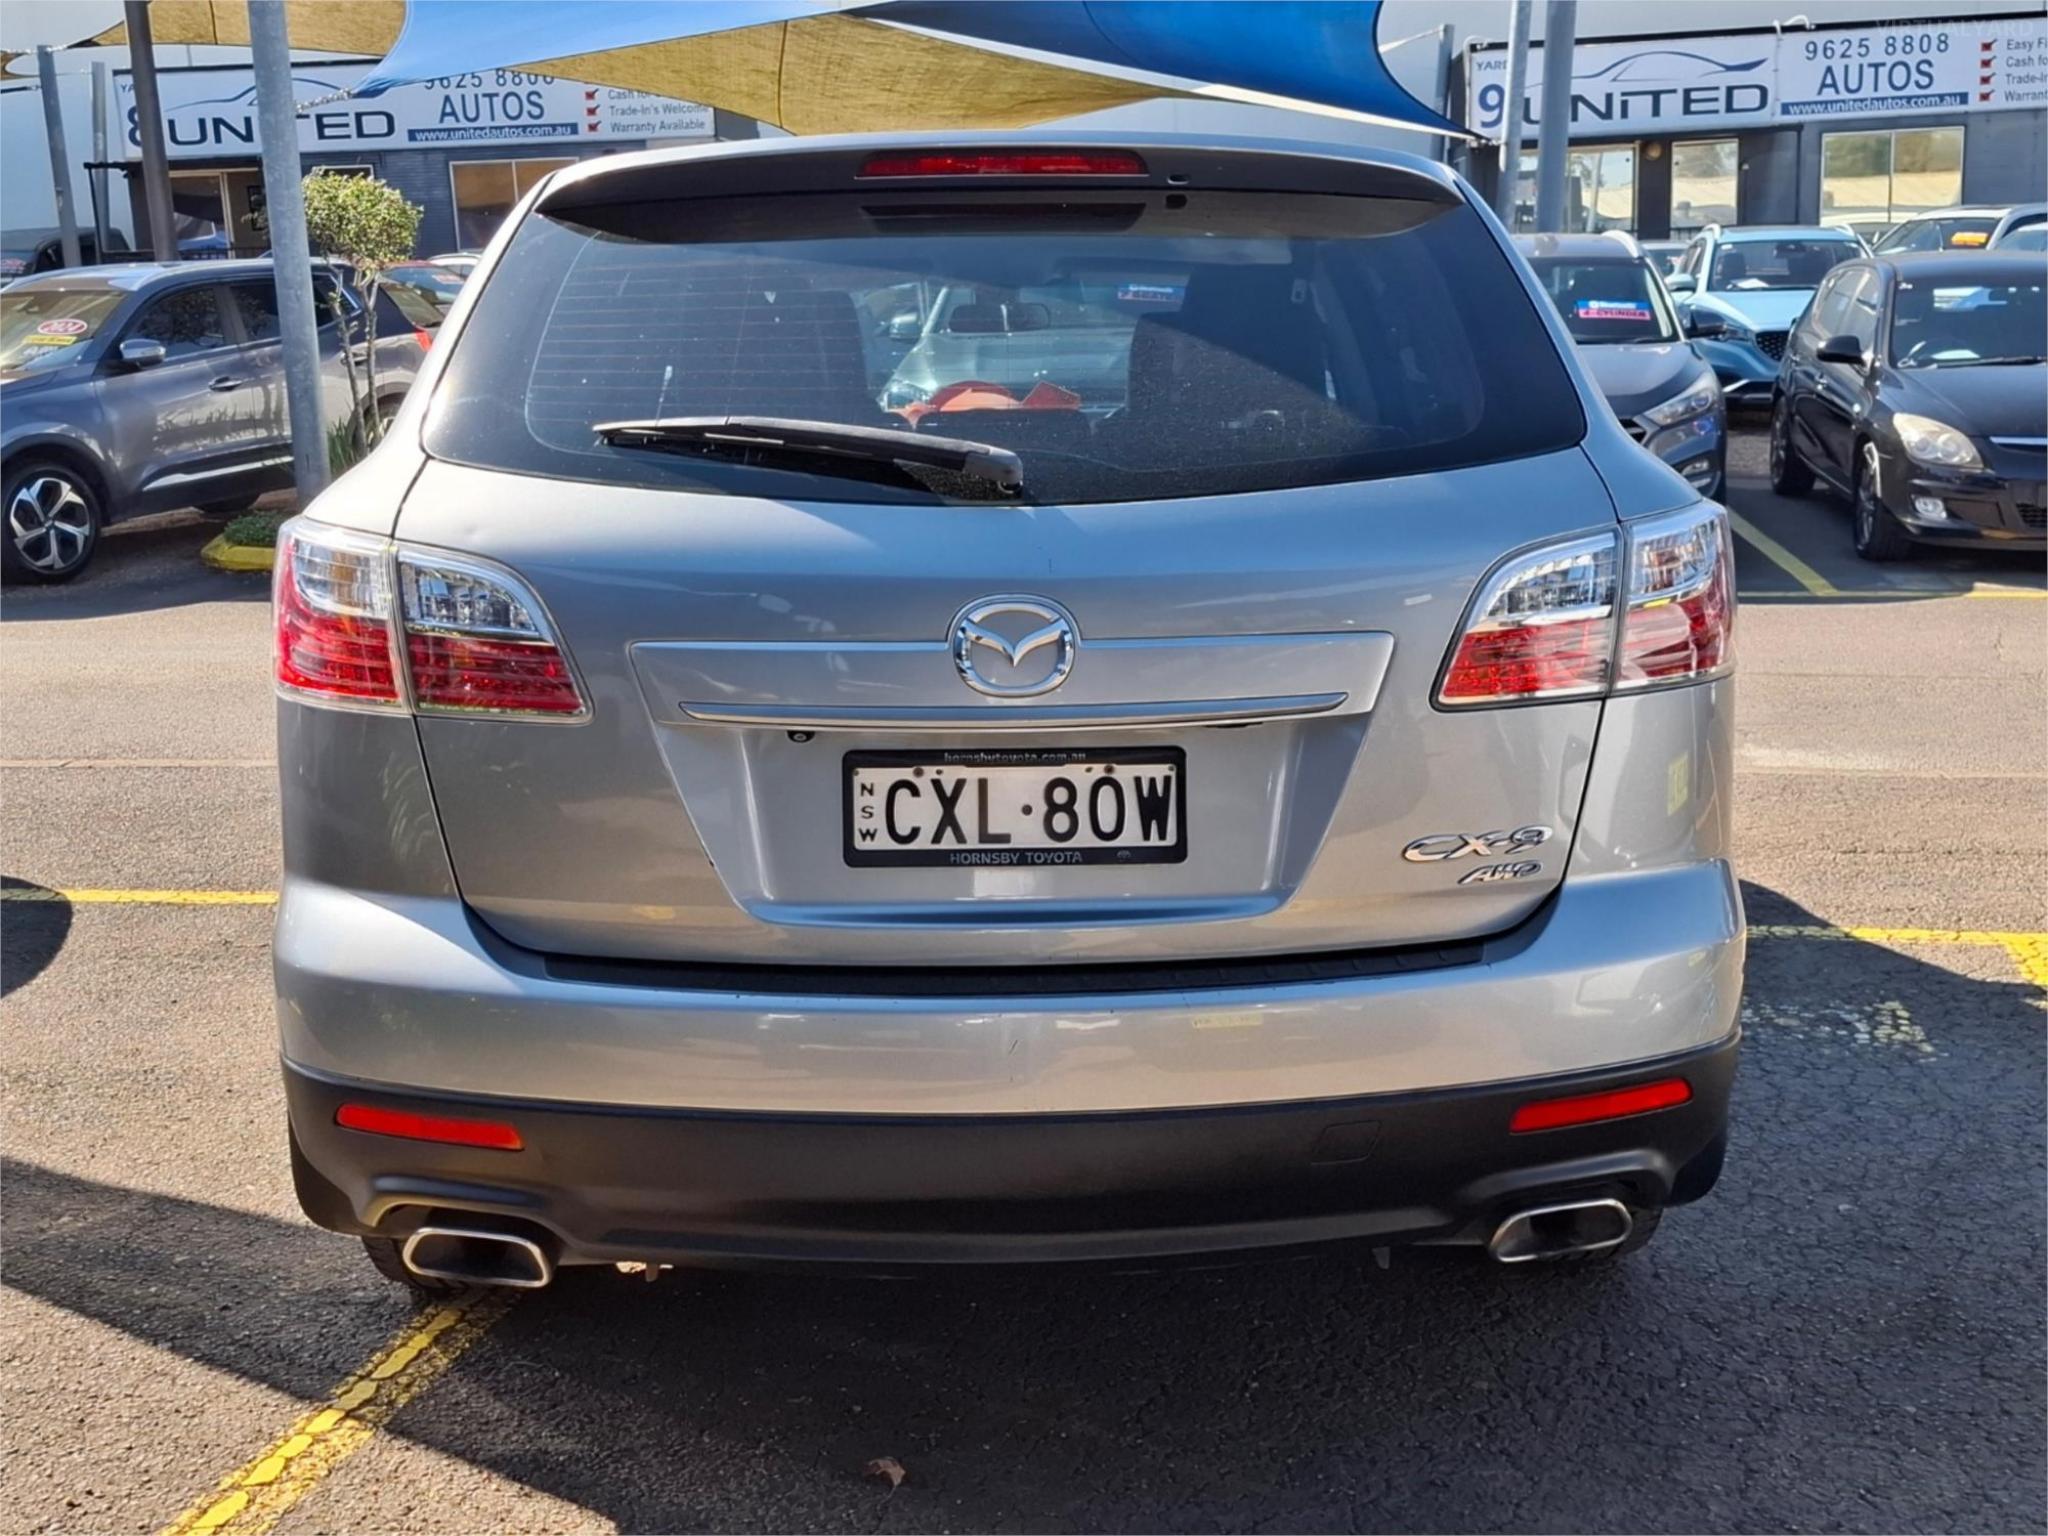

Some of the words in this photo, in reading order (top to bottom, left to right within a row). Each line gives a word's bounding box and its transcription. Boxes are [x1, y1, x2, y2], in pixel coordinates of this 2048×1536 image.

[1804, 38, 1871, 61] 9625
[1884, 33, 1950, 56] 8808
[2006, 38, 2034, 52] Easy
[2005, 55, 2034, 67] Cash
[1817, 59, 1935, 96] AUTOS
[608, 89, 634, 100] Cash
[438, 90, 545, 124] AUTOS
[1789, 95, 1961, 115] www.unitedautos.com.au
[415, 125, 571, 142] www.unitedautos.com.au
[610, 121, 657, 134] Warranty
[659, 119, 706, 131] Available
[1402, 824, 1553, 863] CX-9
[950, 852, 1019, 864] HORNSBY
[1025, 851, 1083, 863] TOYOTA
[1457, 859, 1543, 885] AWD
